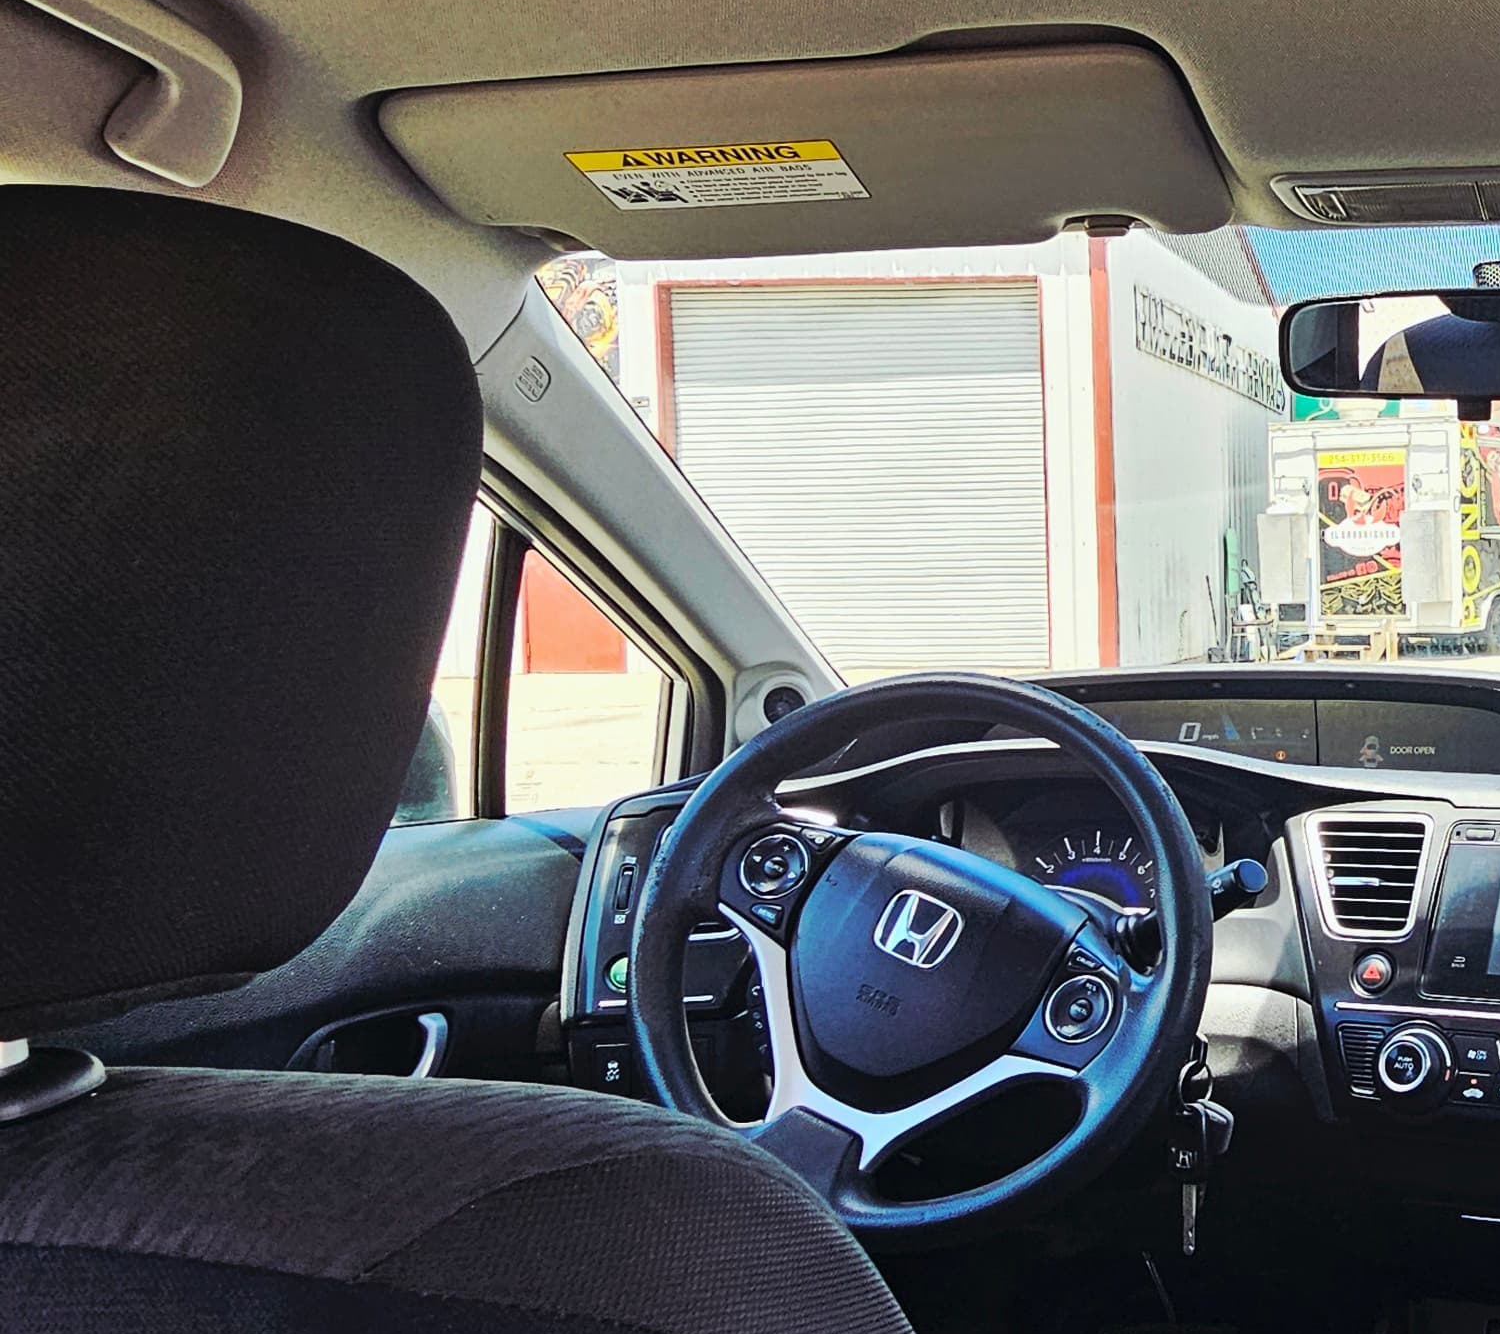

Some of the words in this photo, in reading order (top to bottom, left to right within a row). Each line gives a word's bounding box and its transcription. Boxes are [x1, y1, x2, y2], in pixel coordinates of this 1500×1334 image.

[643, 145, 801, 167] WARNING
[612, 172, 643, 181] EVEN
[651, 170, 682, 179] WITH
[687, 167, 745, 178] ADVANCED
[751, 165, 773, 174] AIR
[1390, 746, 1413, 755] DOOR
[1413, 746, 1436, 755] OPEN
[1393, 1062, 1414, 1070] AUTO
